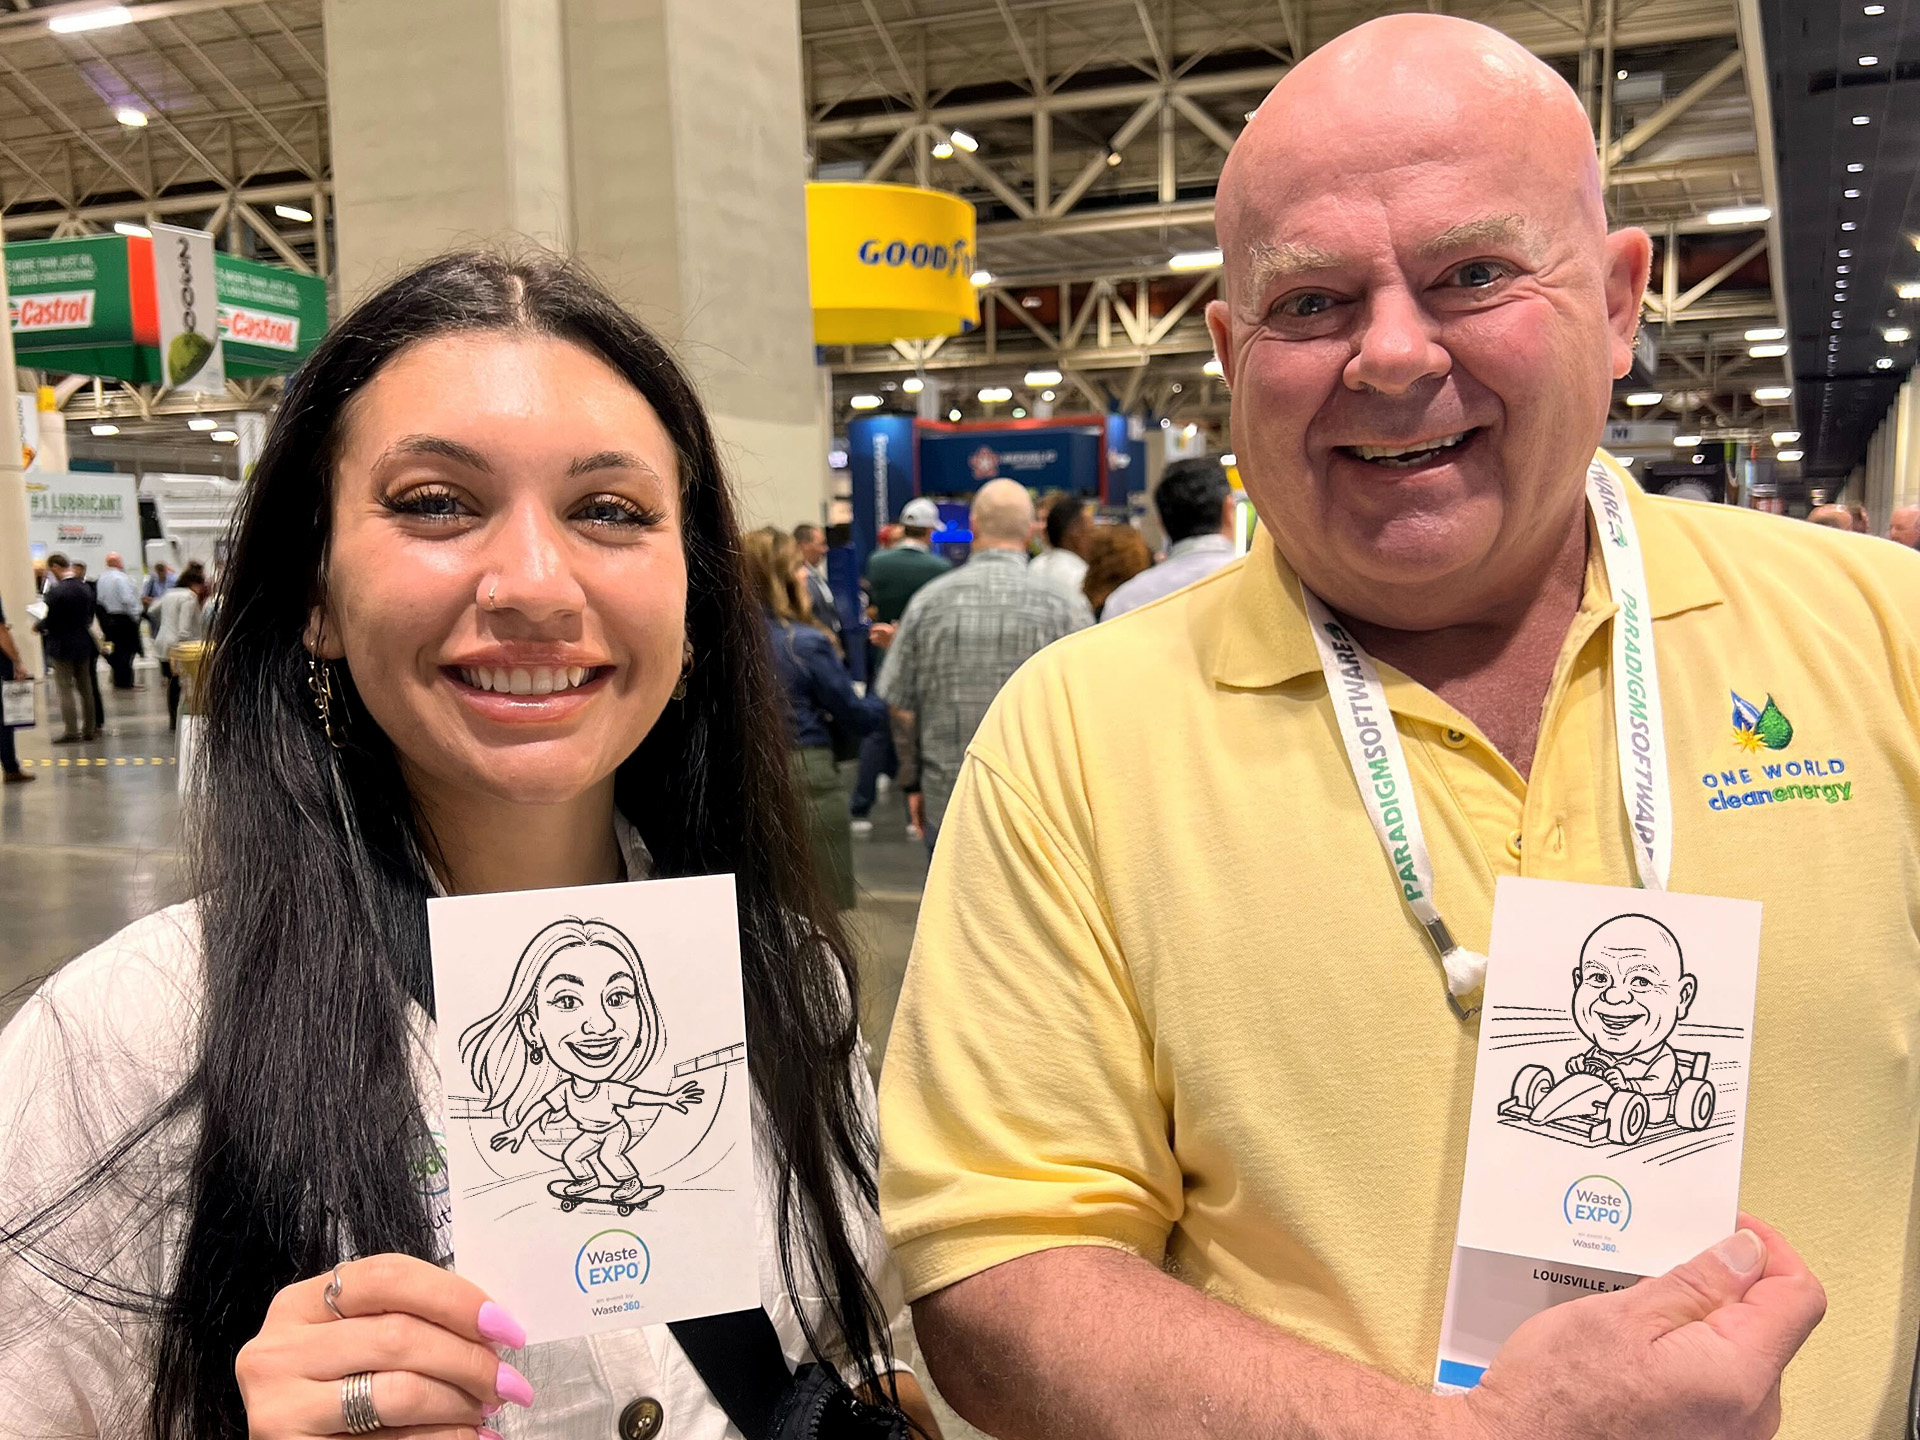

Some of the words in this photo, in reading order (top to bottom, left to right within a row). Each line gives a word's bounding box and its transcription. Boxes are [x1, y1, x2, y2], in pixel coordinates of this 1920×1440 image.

[21, 294, 87, 326] Castrol
[231, 310, 294, 344] Castrol
[51, 494, 123, 512] LUBRICANT
[1621, 587, 1656, 862] PARADIGMSOFTWAR
[1330, 640, 1425, 903] PARADIGMSOFTWARE
[1702, 768, 1753, 789] ONE
[1762, 757, 1846, 780] WORLD
[1707, 780, 1854, 811] cleanenergy
[1576, 1188, 1622, 1207] Waste
[1574, 1204, 1620, 1225] EXPO
[587, 1247, 638, 1266] Waste
[589, 1262, 639, 1286] EXPO
